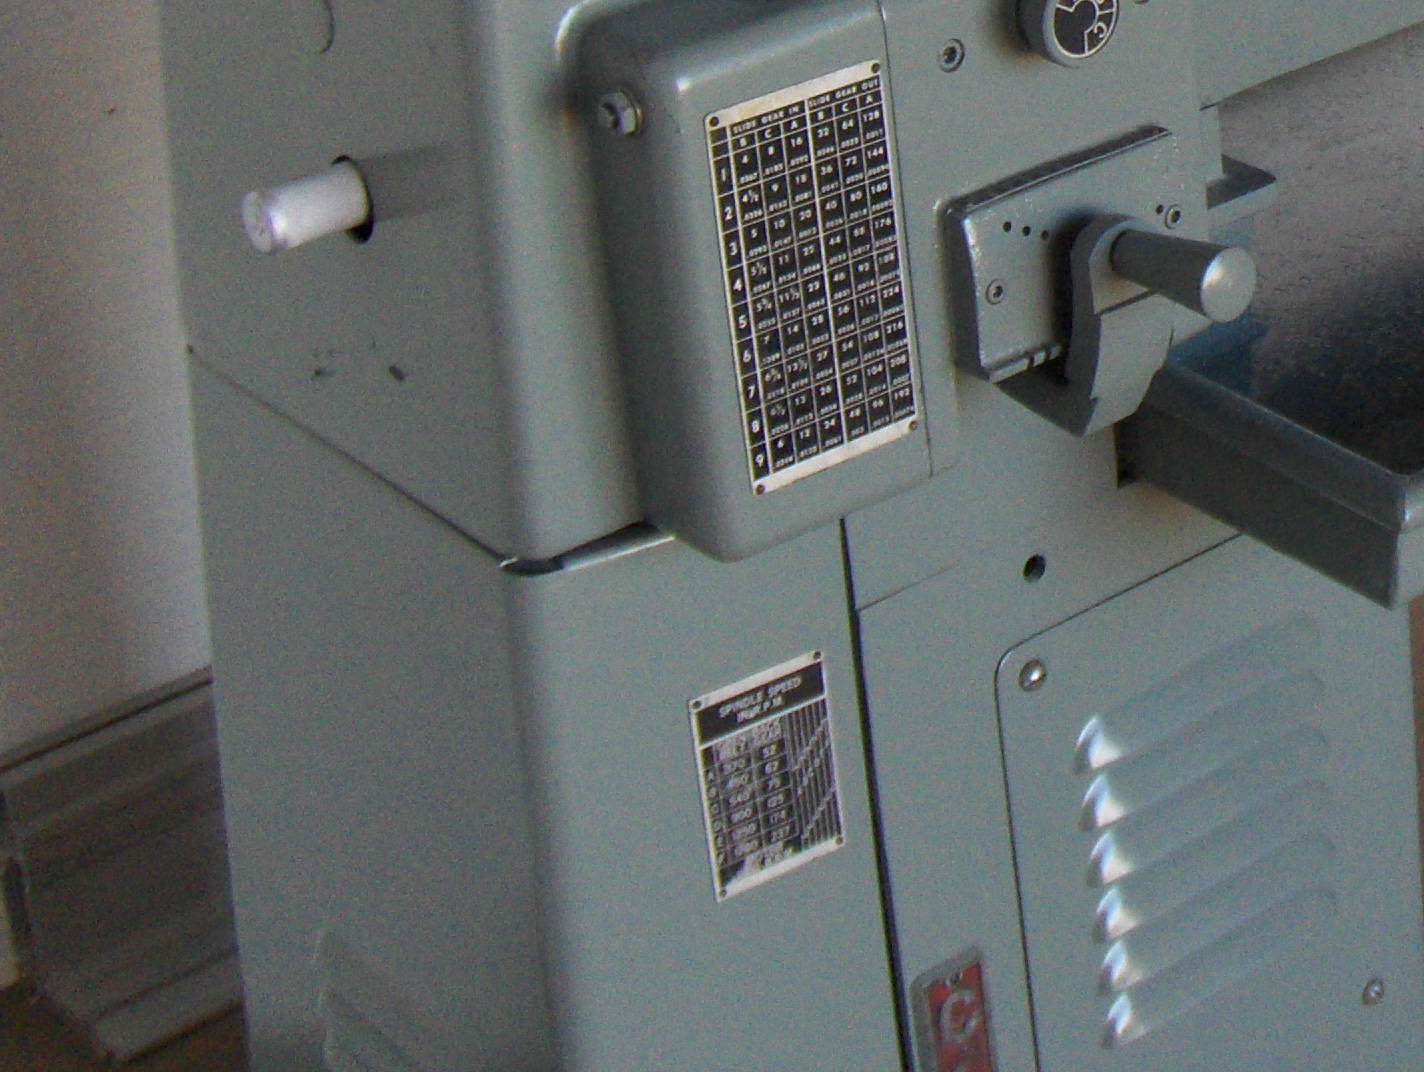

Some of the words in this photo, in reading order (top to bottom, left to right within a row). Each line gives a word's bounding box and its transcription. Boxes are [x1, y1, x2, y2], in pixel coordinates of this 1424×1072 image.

[1093, 21, 1108, 39] C
[808, 95, 831, 107] SLIDE
[835, 87, 857, 98] GEAR
[861, 79, 878, 89] OUT
[864, 94, 874, 105] A
[841, 102, 849, 112] C
[733, 120, 757, 133] SLIDE
[760, 111, 784, 123] GEAR
[788, 105, 800, 115] IN
[817, 111, 825, 120] B
[862, 110, 880, 121] 128
[790, 120, 799, 130] A
[841, 119, 854, 129] 64
[764, 129, 772, 138] C
[816, 127, 830, 137] 32
[739, 138, 748, 147] B
[790, 137, 803, 147] 16
[767, 146, 775, 155] 8
[867, 147, 884, 158] 144
[741, 154, 749, 164] 4
[844, 156, 858, 166] 72
[720, 169, 727, 181] 1
[820, 165, 834, 175] 36
[771, 183, 779, 192] 9
[870, 182, 888, 193] 160
[824, 200, 838, 210] 40
[724, 207, 733, 220] 2
[798, 210, 812, 220] 20
[773, 219, 786, 229] 10
[874, 218, 892, 228] 176
[750, 229, 758, 238] 5
[828, 236, 842, 245] 44
[728, 242, 738, 255] 3
[802, 245, 815, 256] 22
[778, 255, 790, 264] 11
[857, 262, 870, 271] 92
[832, 272, 846, 281] 46
[733, 279, 743, 290] 4
[807, 281, 820, 292] 23
[882, 286, 900, 298] 224
[859, 294, 876, 306] 112
[738, 315, 748, 328] 5
[786, 325, 799, 334] 14
[886, 321, 904, 333] 216
[763, 335, 770, 344] 7
[742, 350, 752, 362] 6
[816, 350, 829, 361] 27
[866, 364, 884, 375] 104
[845, 375, 858, 385] 52
[747, 385, 756, 398] 7
[894, 388, 910, 399] 192
[794, 395, 807, 405] 13
[871, 399, 884, 408] 96
[751, 420, 760, 433] 8
[823, 419, 836, 429] 24
[799, 429, 811, 438] 12
[776, 439, 785, 449] 6
[754, 454, 765, 466] 9
